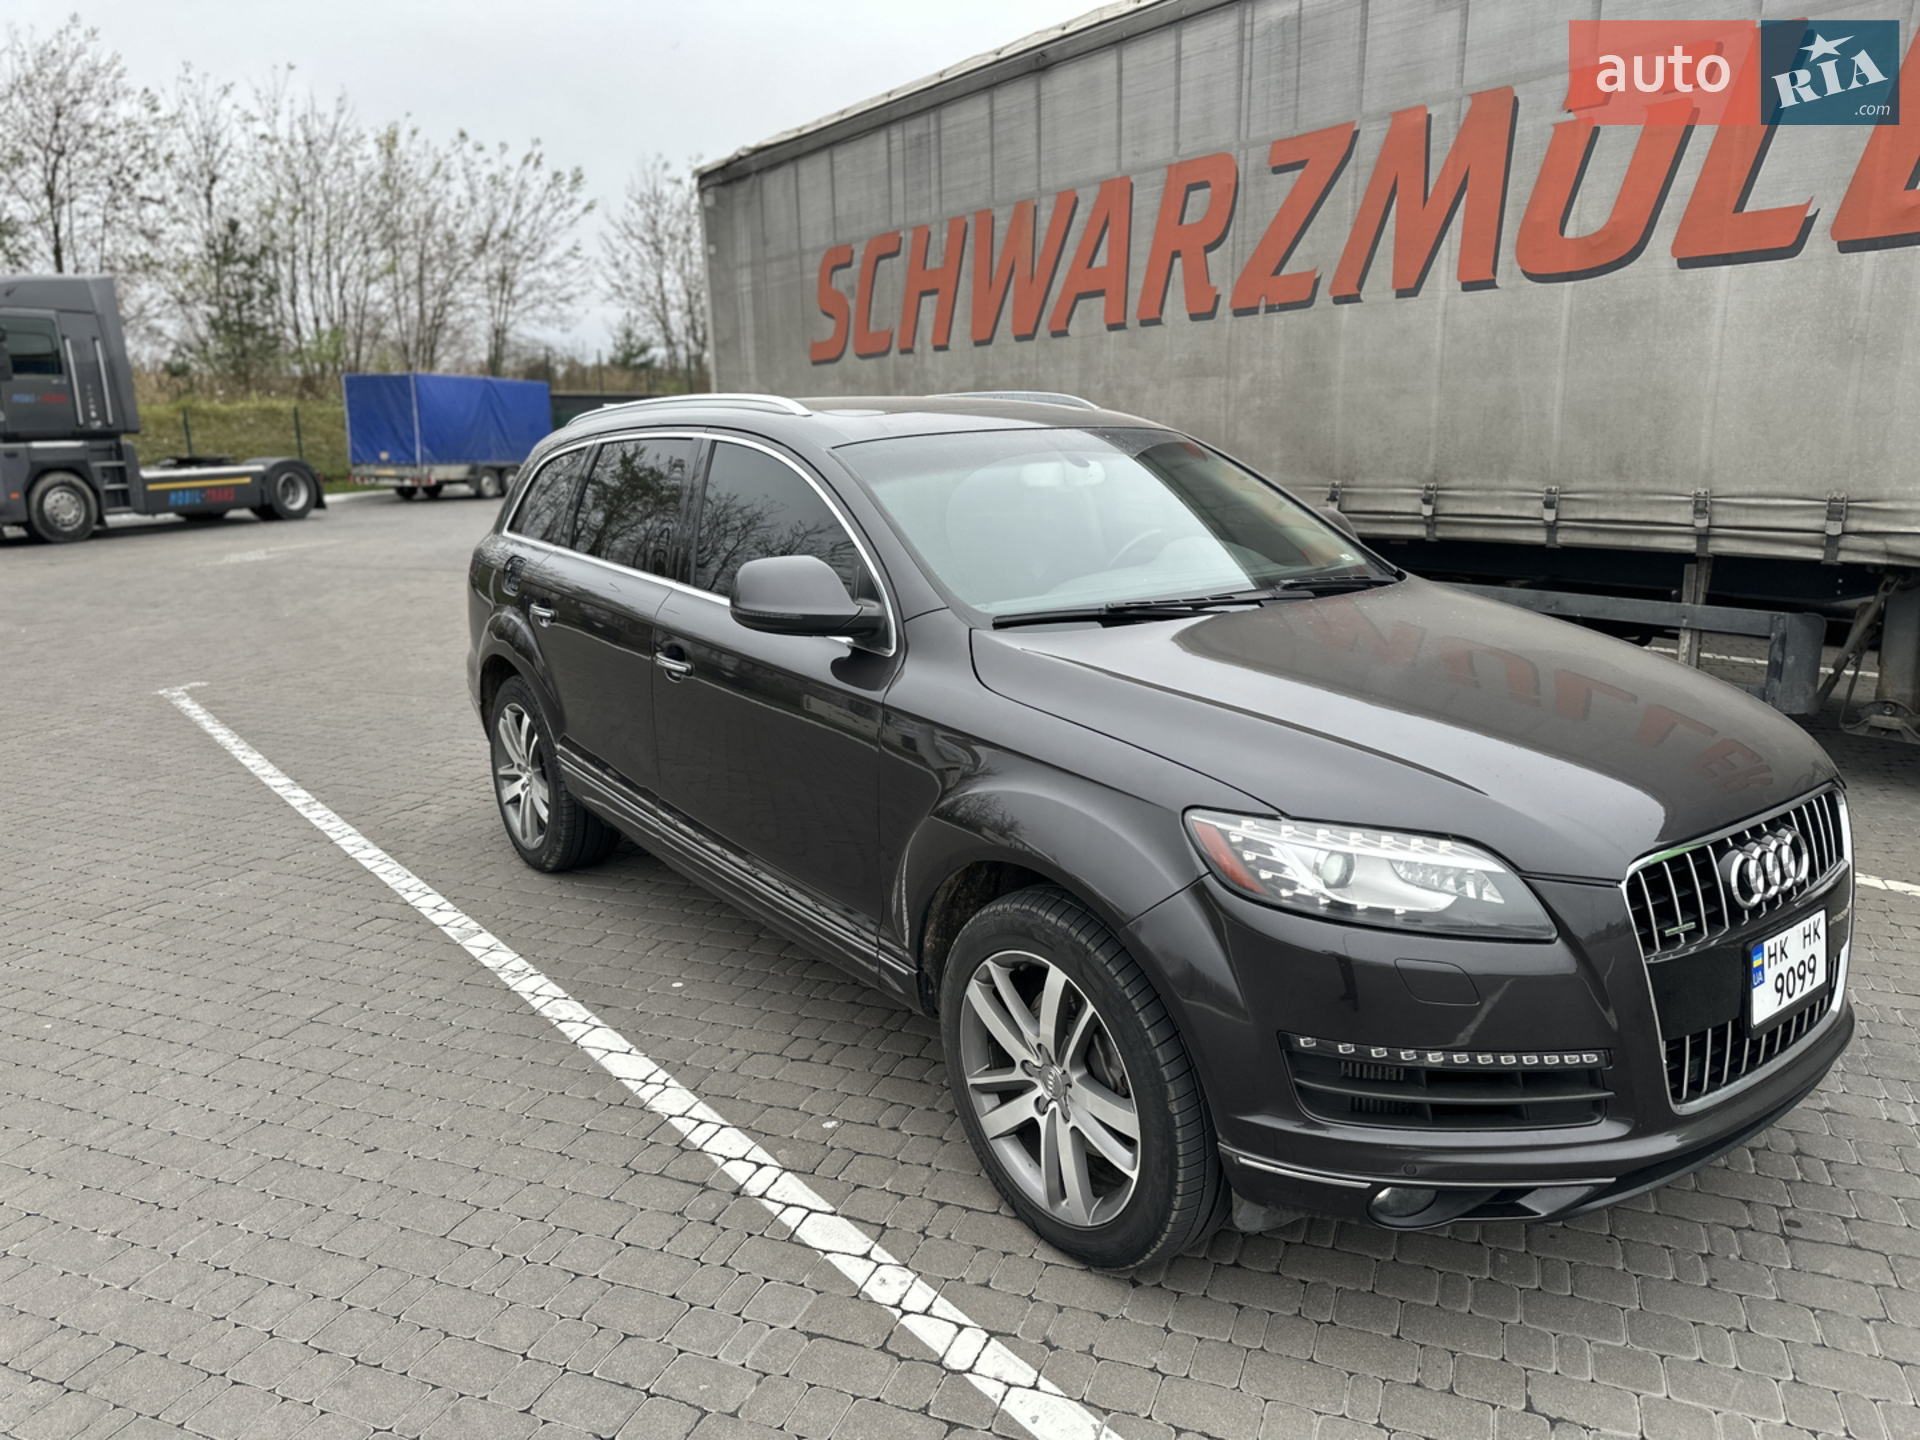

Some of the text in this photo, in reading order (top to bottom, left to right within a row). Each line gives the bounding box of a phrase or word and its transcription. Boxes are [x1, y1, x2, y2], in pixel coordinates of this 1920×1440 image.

[1768, 918, 1821, 969] HK HK
[1774, 953, 1817, 1007] 9099
